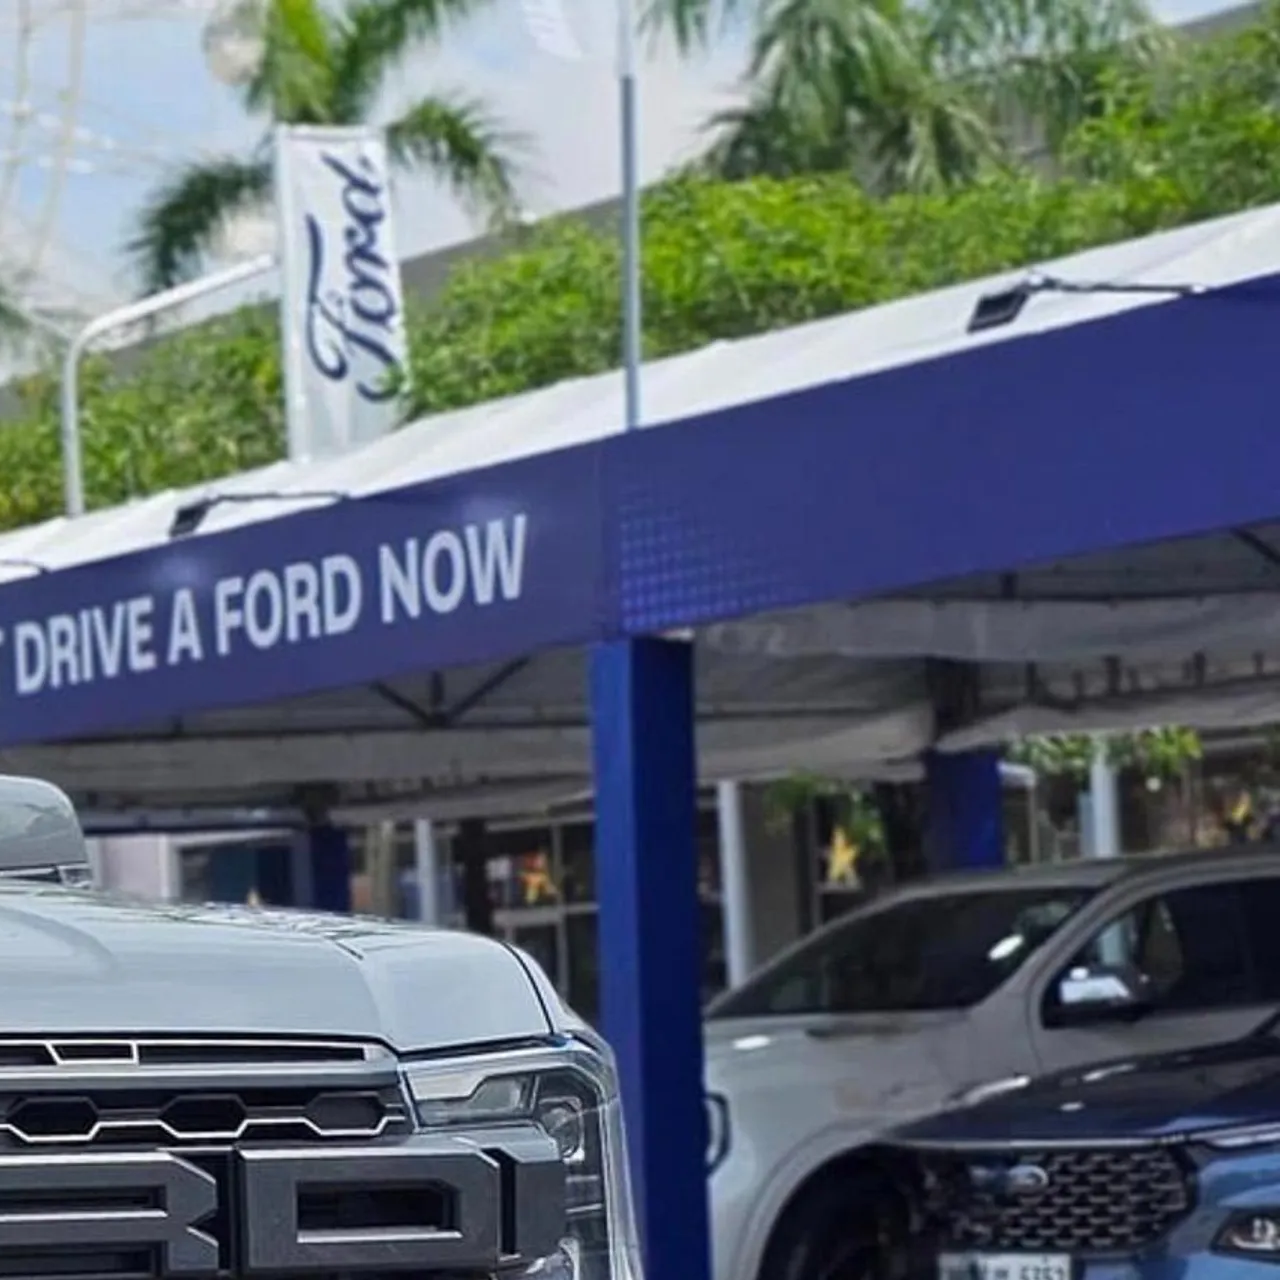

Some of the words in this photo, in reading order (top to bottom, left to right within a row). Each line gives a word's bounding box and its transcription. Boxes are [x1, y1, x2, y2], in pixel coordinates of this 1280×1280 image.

[305, 151, 403, 402] Ford
[14, 595, 157, 694] DRIVE
[167, 588, 203, 666] A
[214, 554, 362, 655] FORD
[379, 513, 528, 623] NOW
